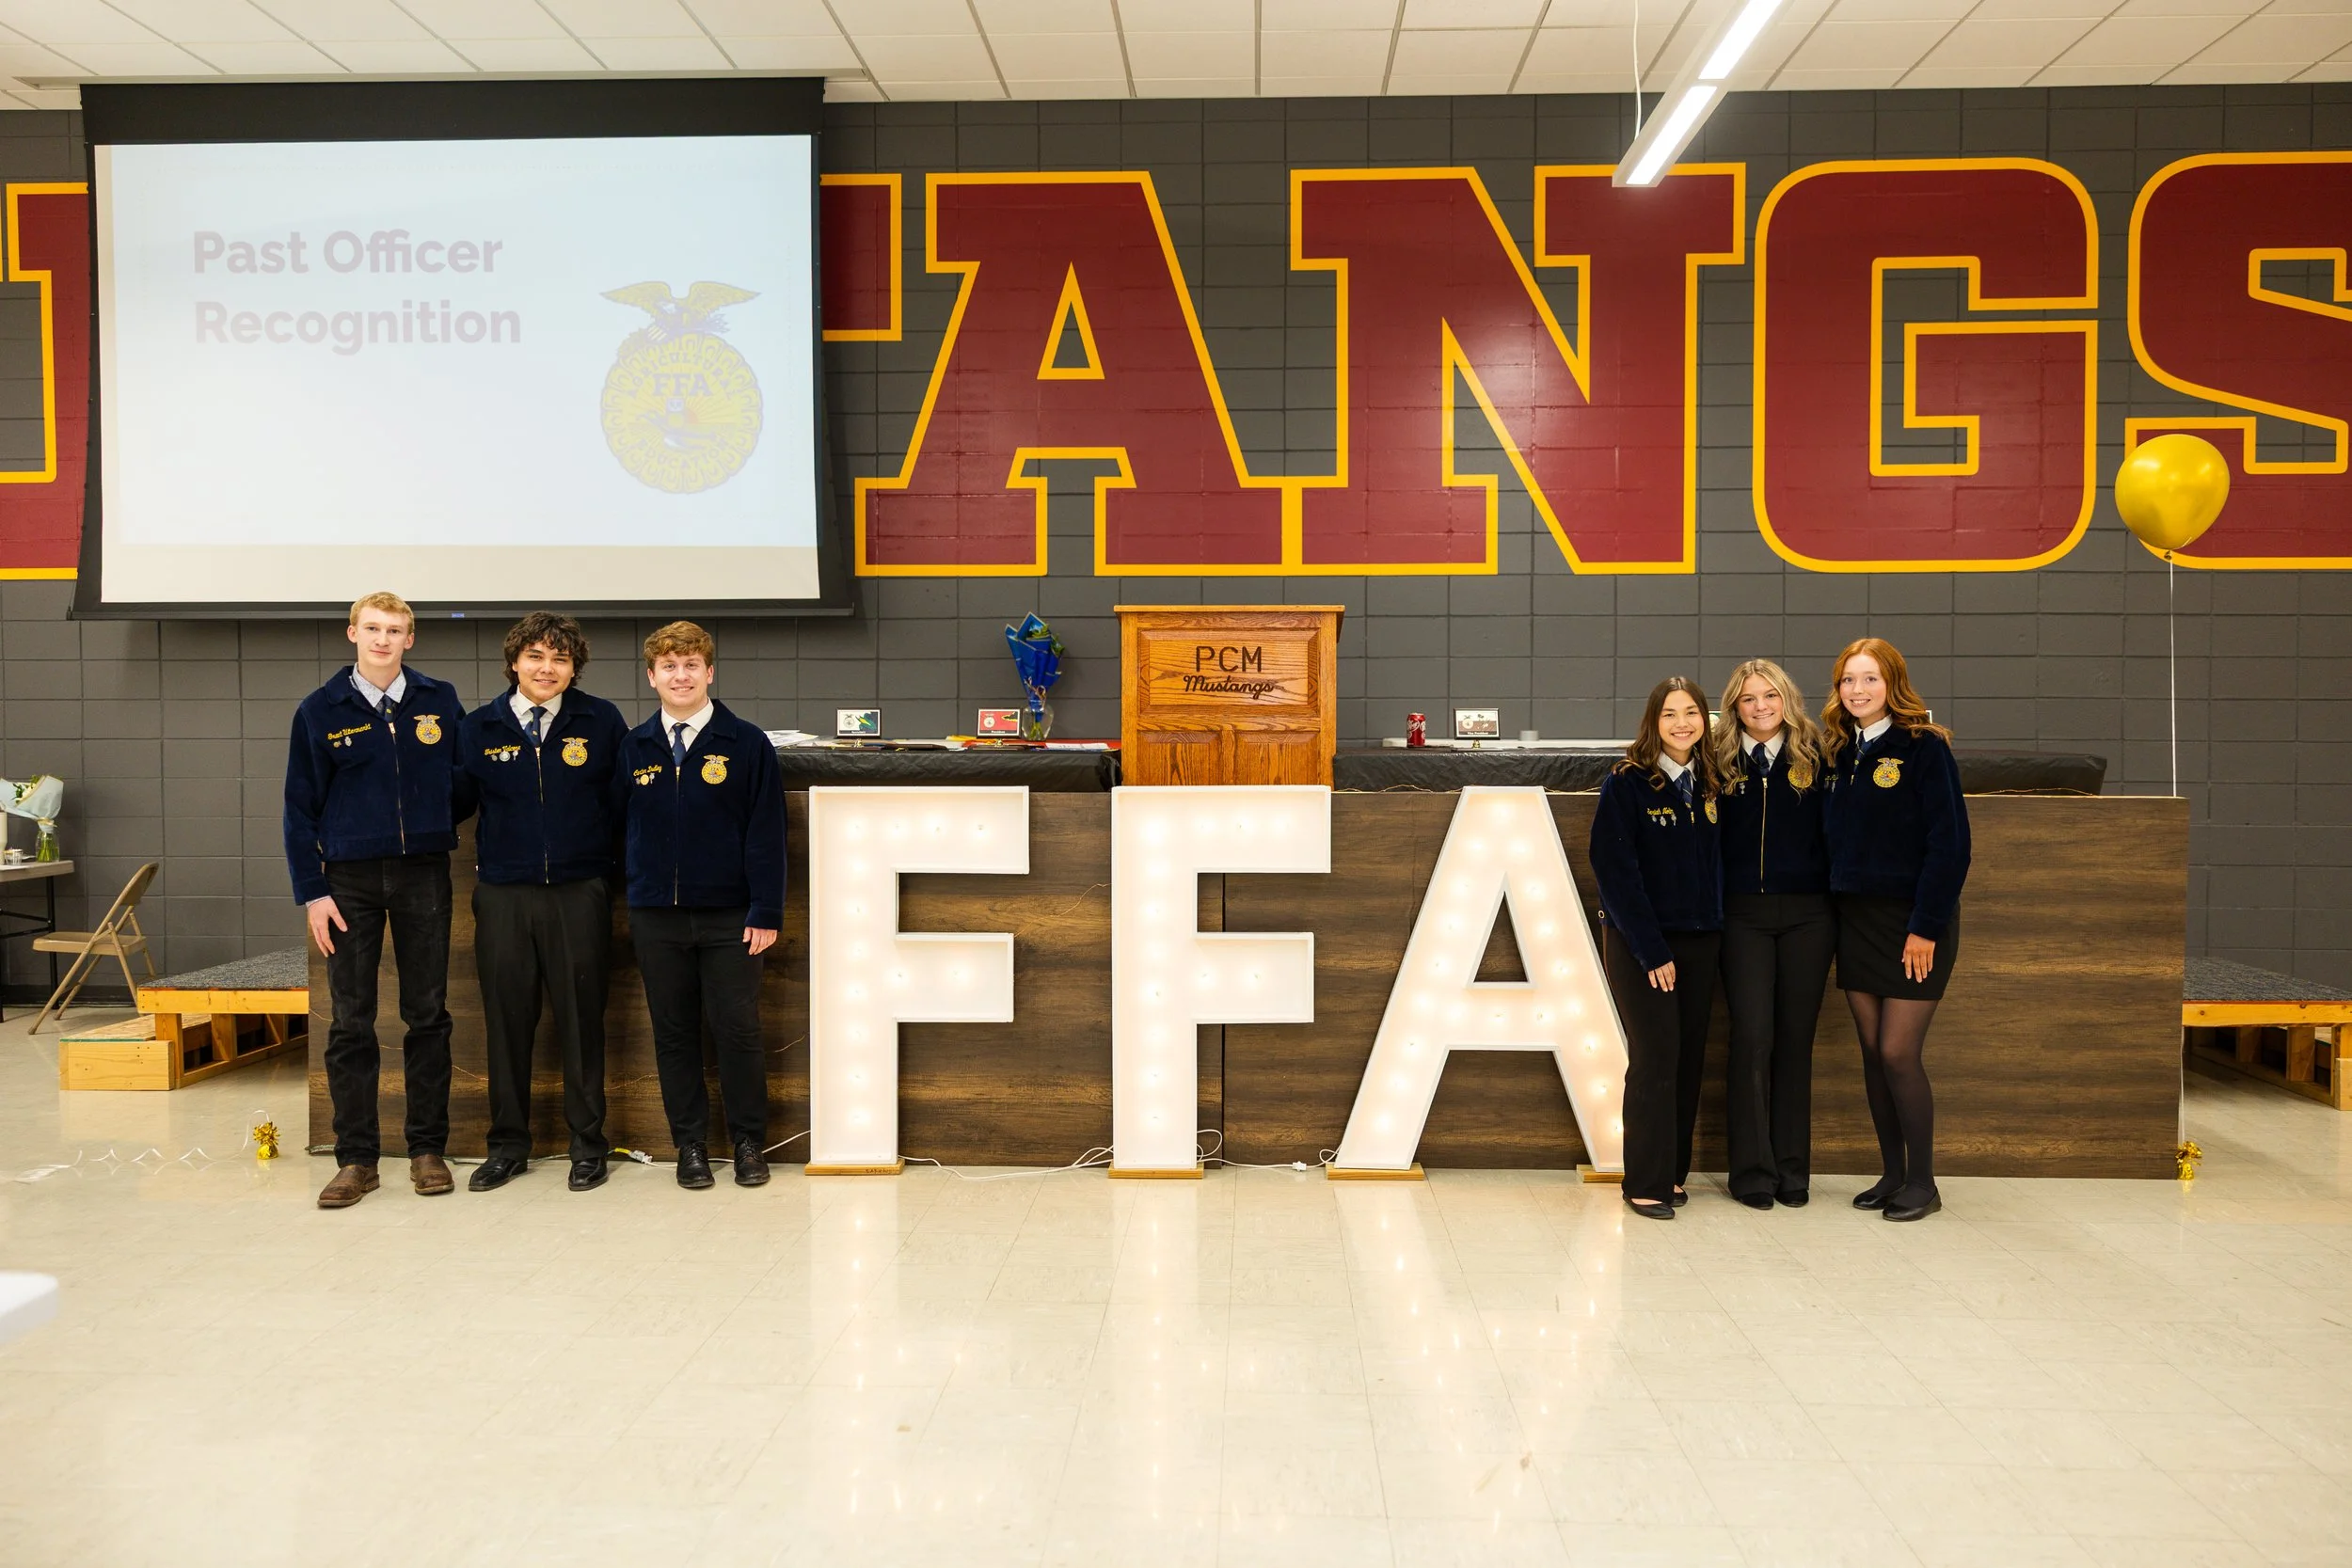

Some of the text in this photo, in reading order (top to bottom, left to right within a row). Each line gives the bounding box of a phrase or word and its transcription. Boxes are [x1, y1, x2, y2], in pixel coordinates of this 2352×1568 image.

[193, 229, 503, 275] Past Officer
[195, 299, 522, 356] Recognition
[653, 372, 712, 397] FFA
[819, 152, 2352, 578] ANGS
[1195, 645, 1263, 673] PCM
[1183, 674, 1274, 700] Mustangs
[808, 784, 1629, 1171] FFA
